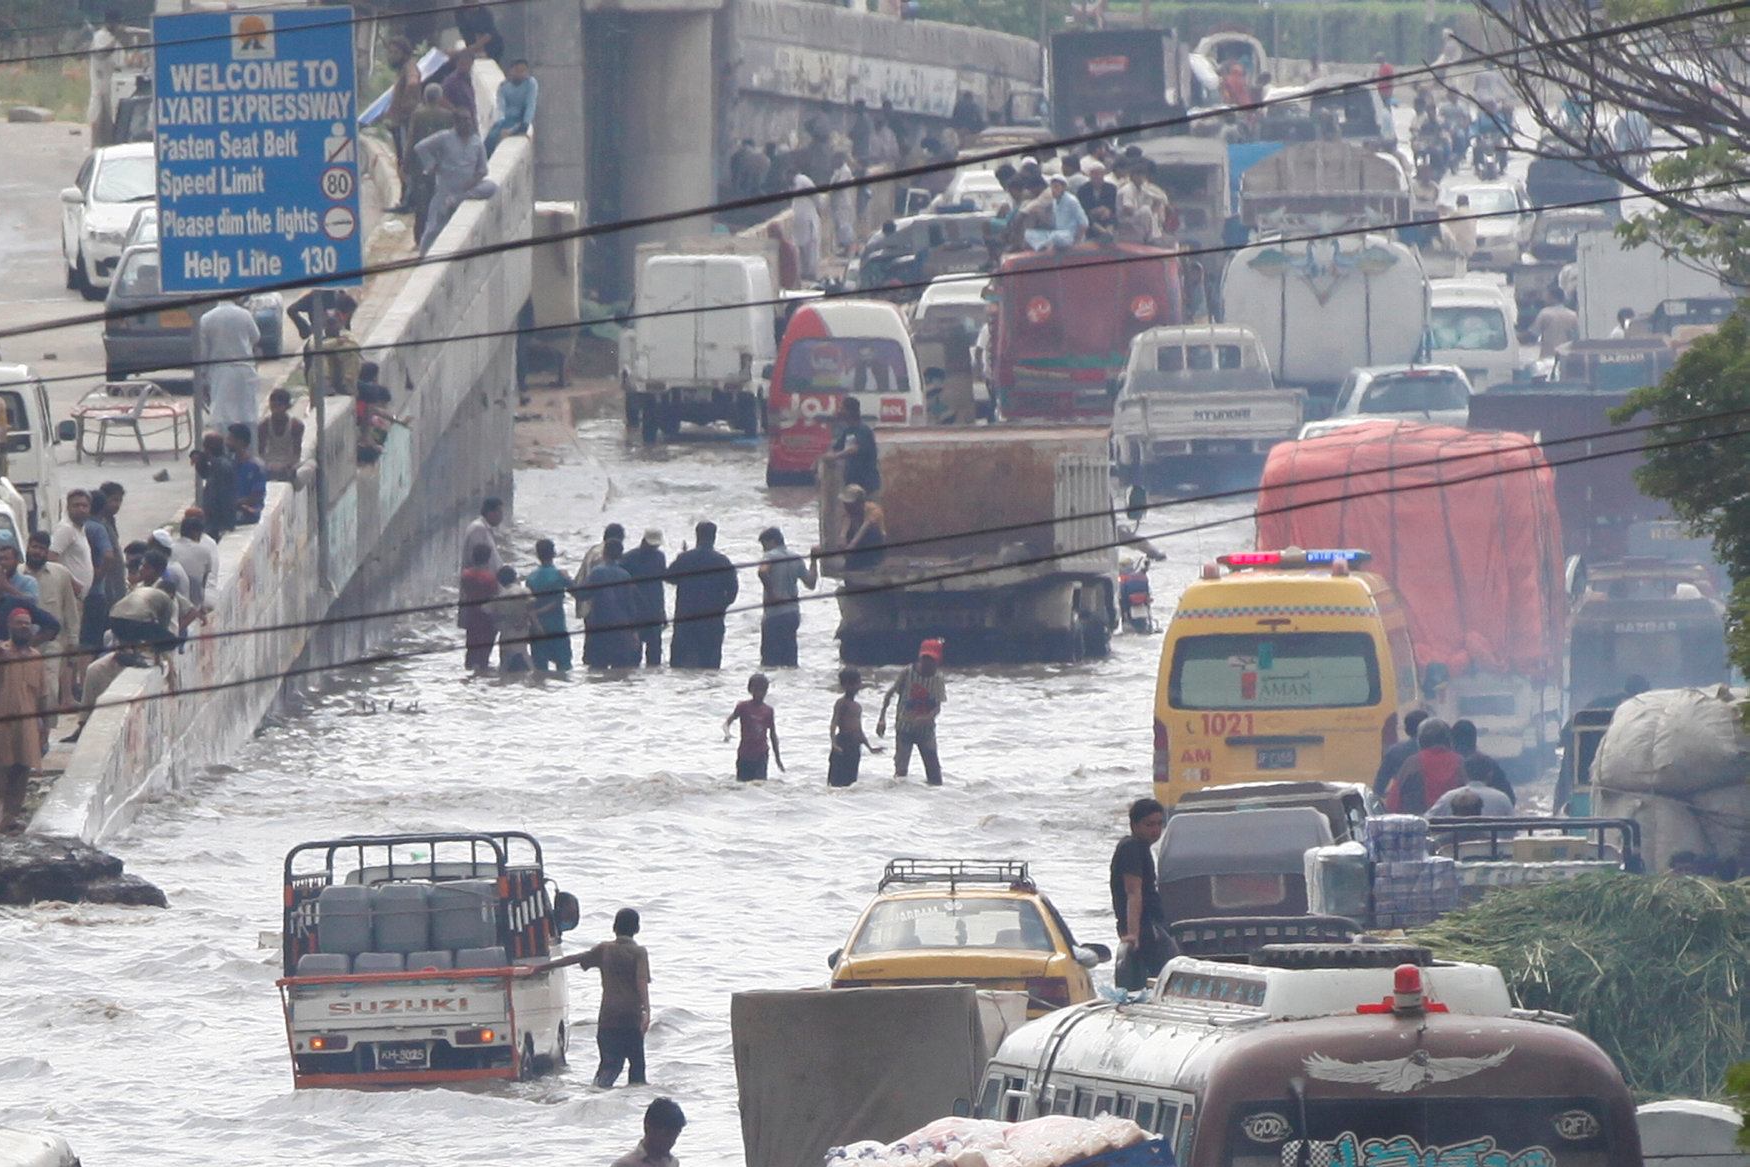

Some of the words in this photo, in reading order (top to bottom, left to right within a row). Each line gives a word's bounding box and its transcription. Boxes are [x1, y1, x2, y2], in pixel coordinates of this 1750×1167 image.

[170, 60, 298, 92] WELCOME
[303, 59, 338, 88] TO
[157, 97, 212, 125] LYARI
[218, 91, 351, 123] EXPRESSWAY
[158, 133, 215, 161] Fasten
[220, 130, 259, 159] Seat
[264, 129, 298, 157] Belt
[160, 167, 216, 202] Speed
[221, 165, 265, 195] Limit
[327, 173, 349, 195] 80
[162, 210, 214, 237] Please
[217, 207, 244, 235] dim
[246, 207, 272, 234] the
[276, 206, 319, 241] lights
[184, 250, 231, 284] Help
[237, 249, 282, 277] Line
[301, 246, 337, 275] 130
[1260, 682, 1312, 697] AMAN
[1202, 712, 1254, 736] 1021
[1180, 749, 1212, 763] AM
[328, 998, 468, 1017] SUZUKI
[1253, 1119, 1281, 1137] GOD
